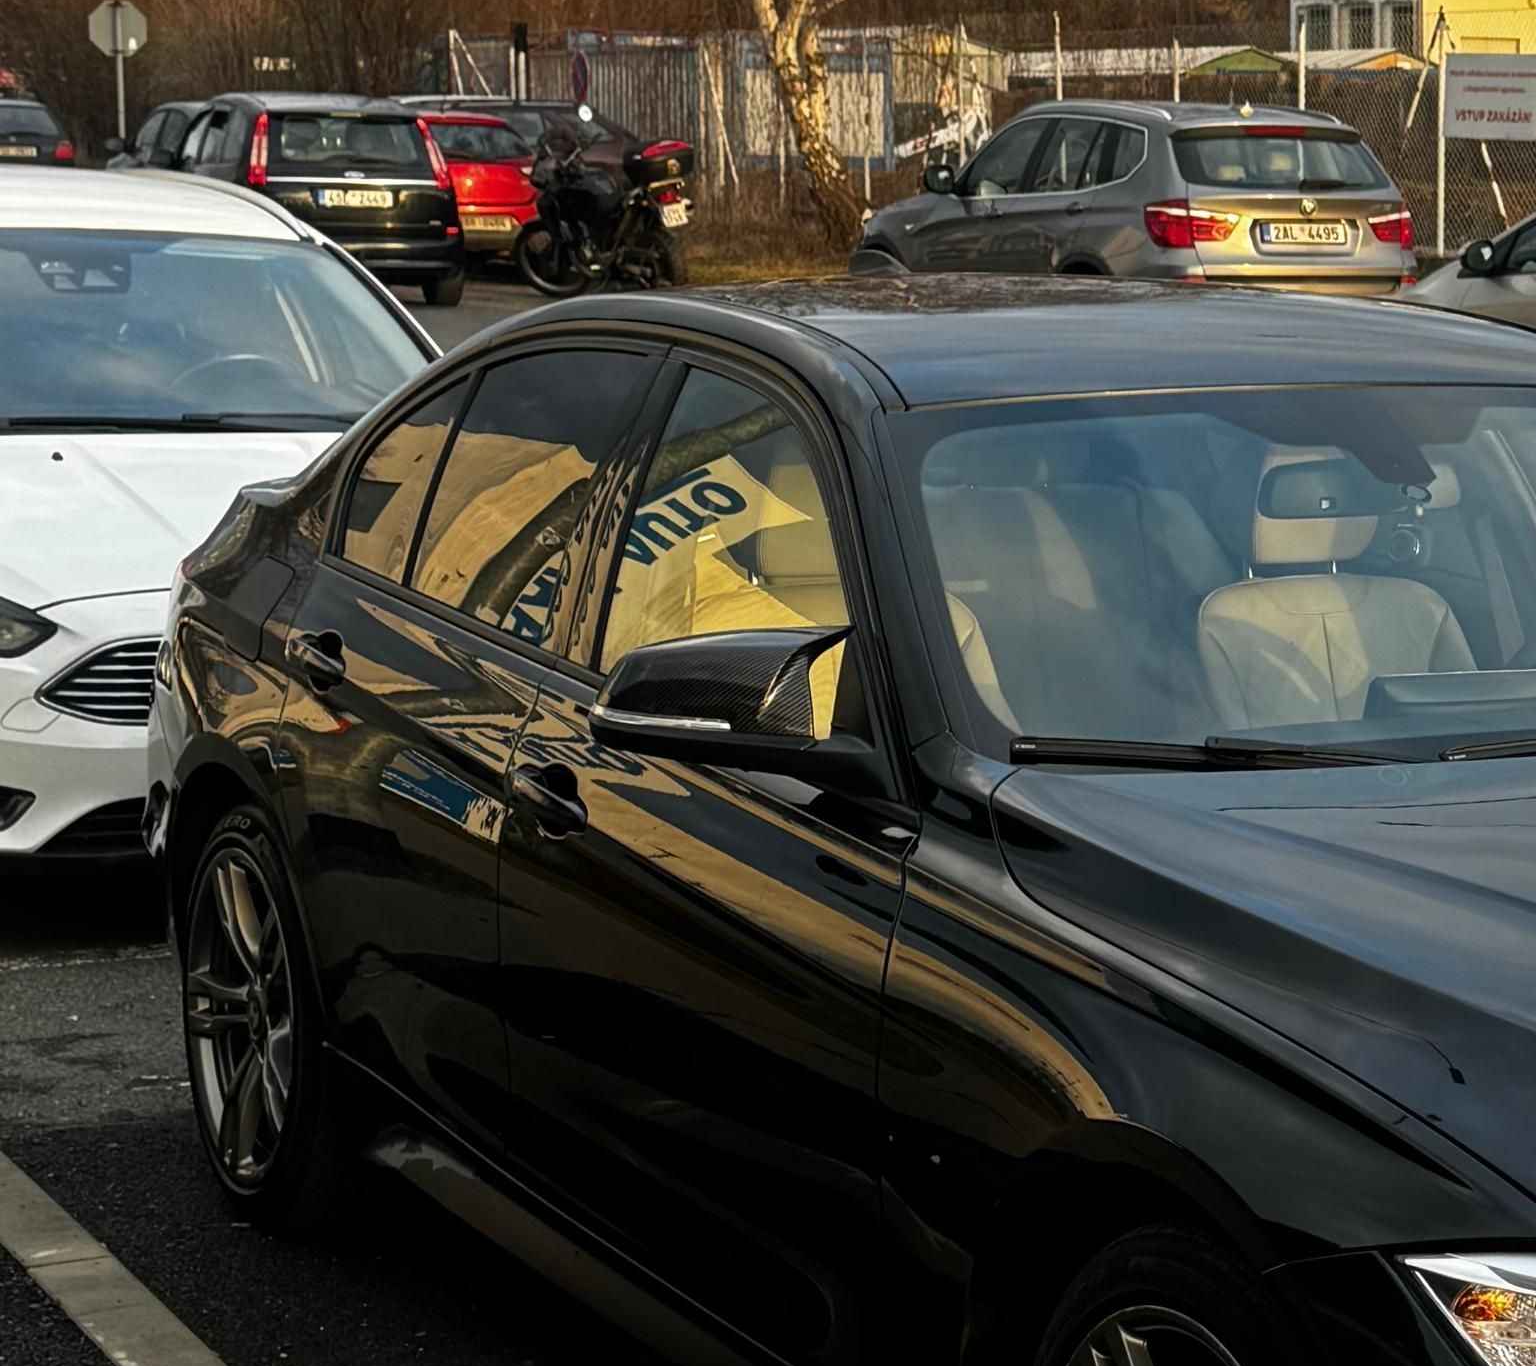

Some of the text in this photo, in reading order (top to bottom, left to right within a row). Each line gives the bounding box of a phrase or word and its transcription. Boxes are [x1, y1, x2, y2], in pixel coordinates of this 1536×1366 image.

[1455, 108, 1485, 122] VSTUP
[1274, 226, 1339, 241] 2AL 4495
